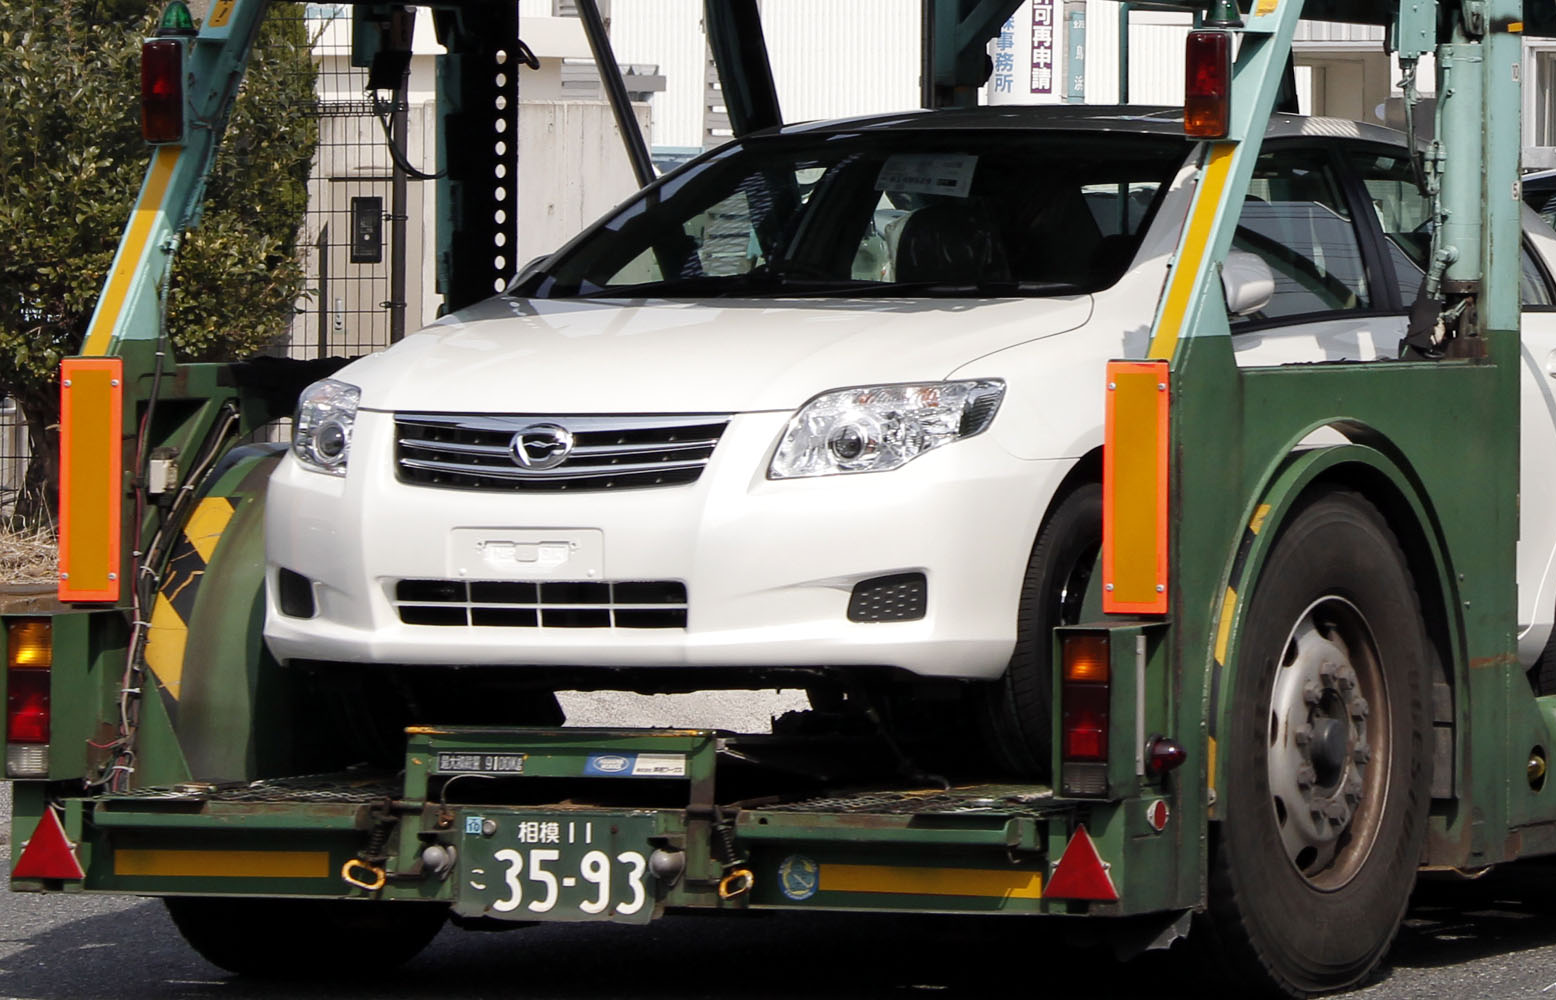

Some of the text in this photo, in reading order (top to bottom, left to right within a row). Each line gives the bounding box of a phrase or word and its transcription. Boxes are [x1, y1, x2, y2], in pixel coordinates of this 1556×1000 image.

[518, 821, 592, 845] 相模 11
[469, 848, 647, 916] こ 35-93
